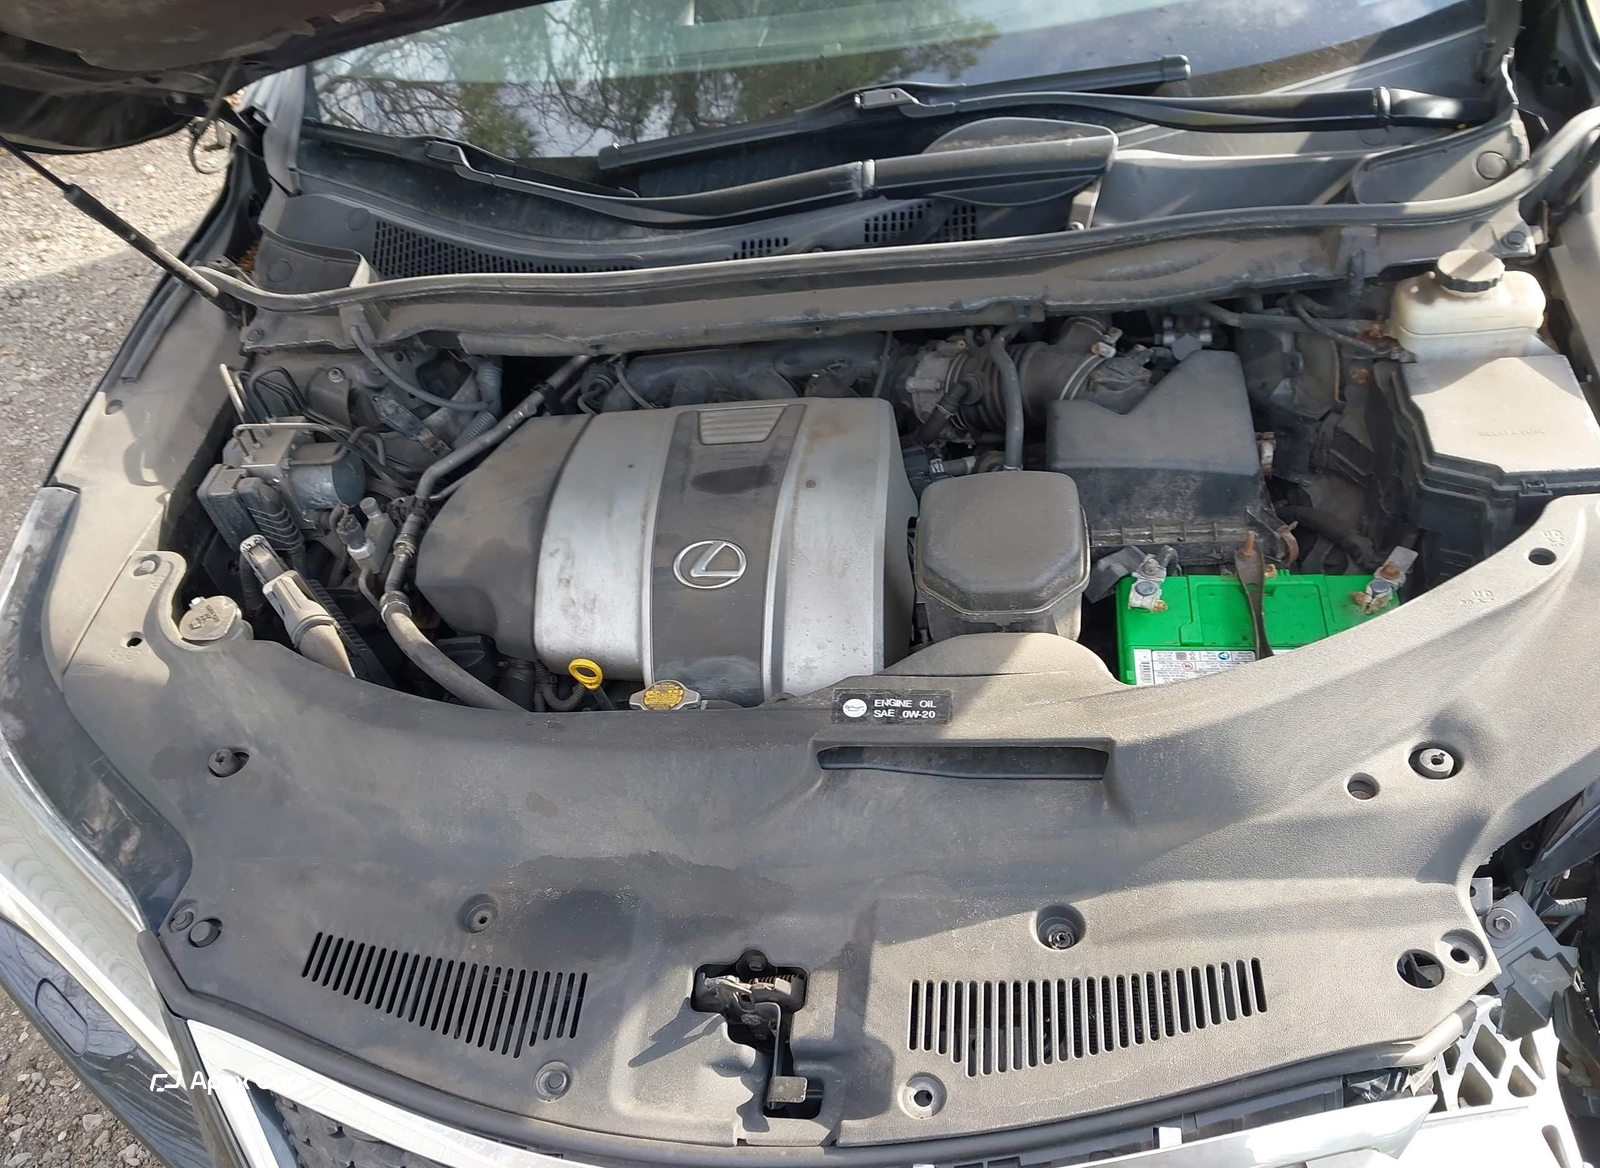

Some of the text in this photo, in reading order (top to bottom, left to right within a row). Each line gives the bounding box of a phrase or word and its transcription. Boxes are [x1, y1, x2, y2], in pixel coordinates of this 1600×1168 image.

[873, 698, 937, 709] ENGINE OIL
[873, 709, 936, 719] SAE 0W-20
